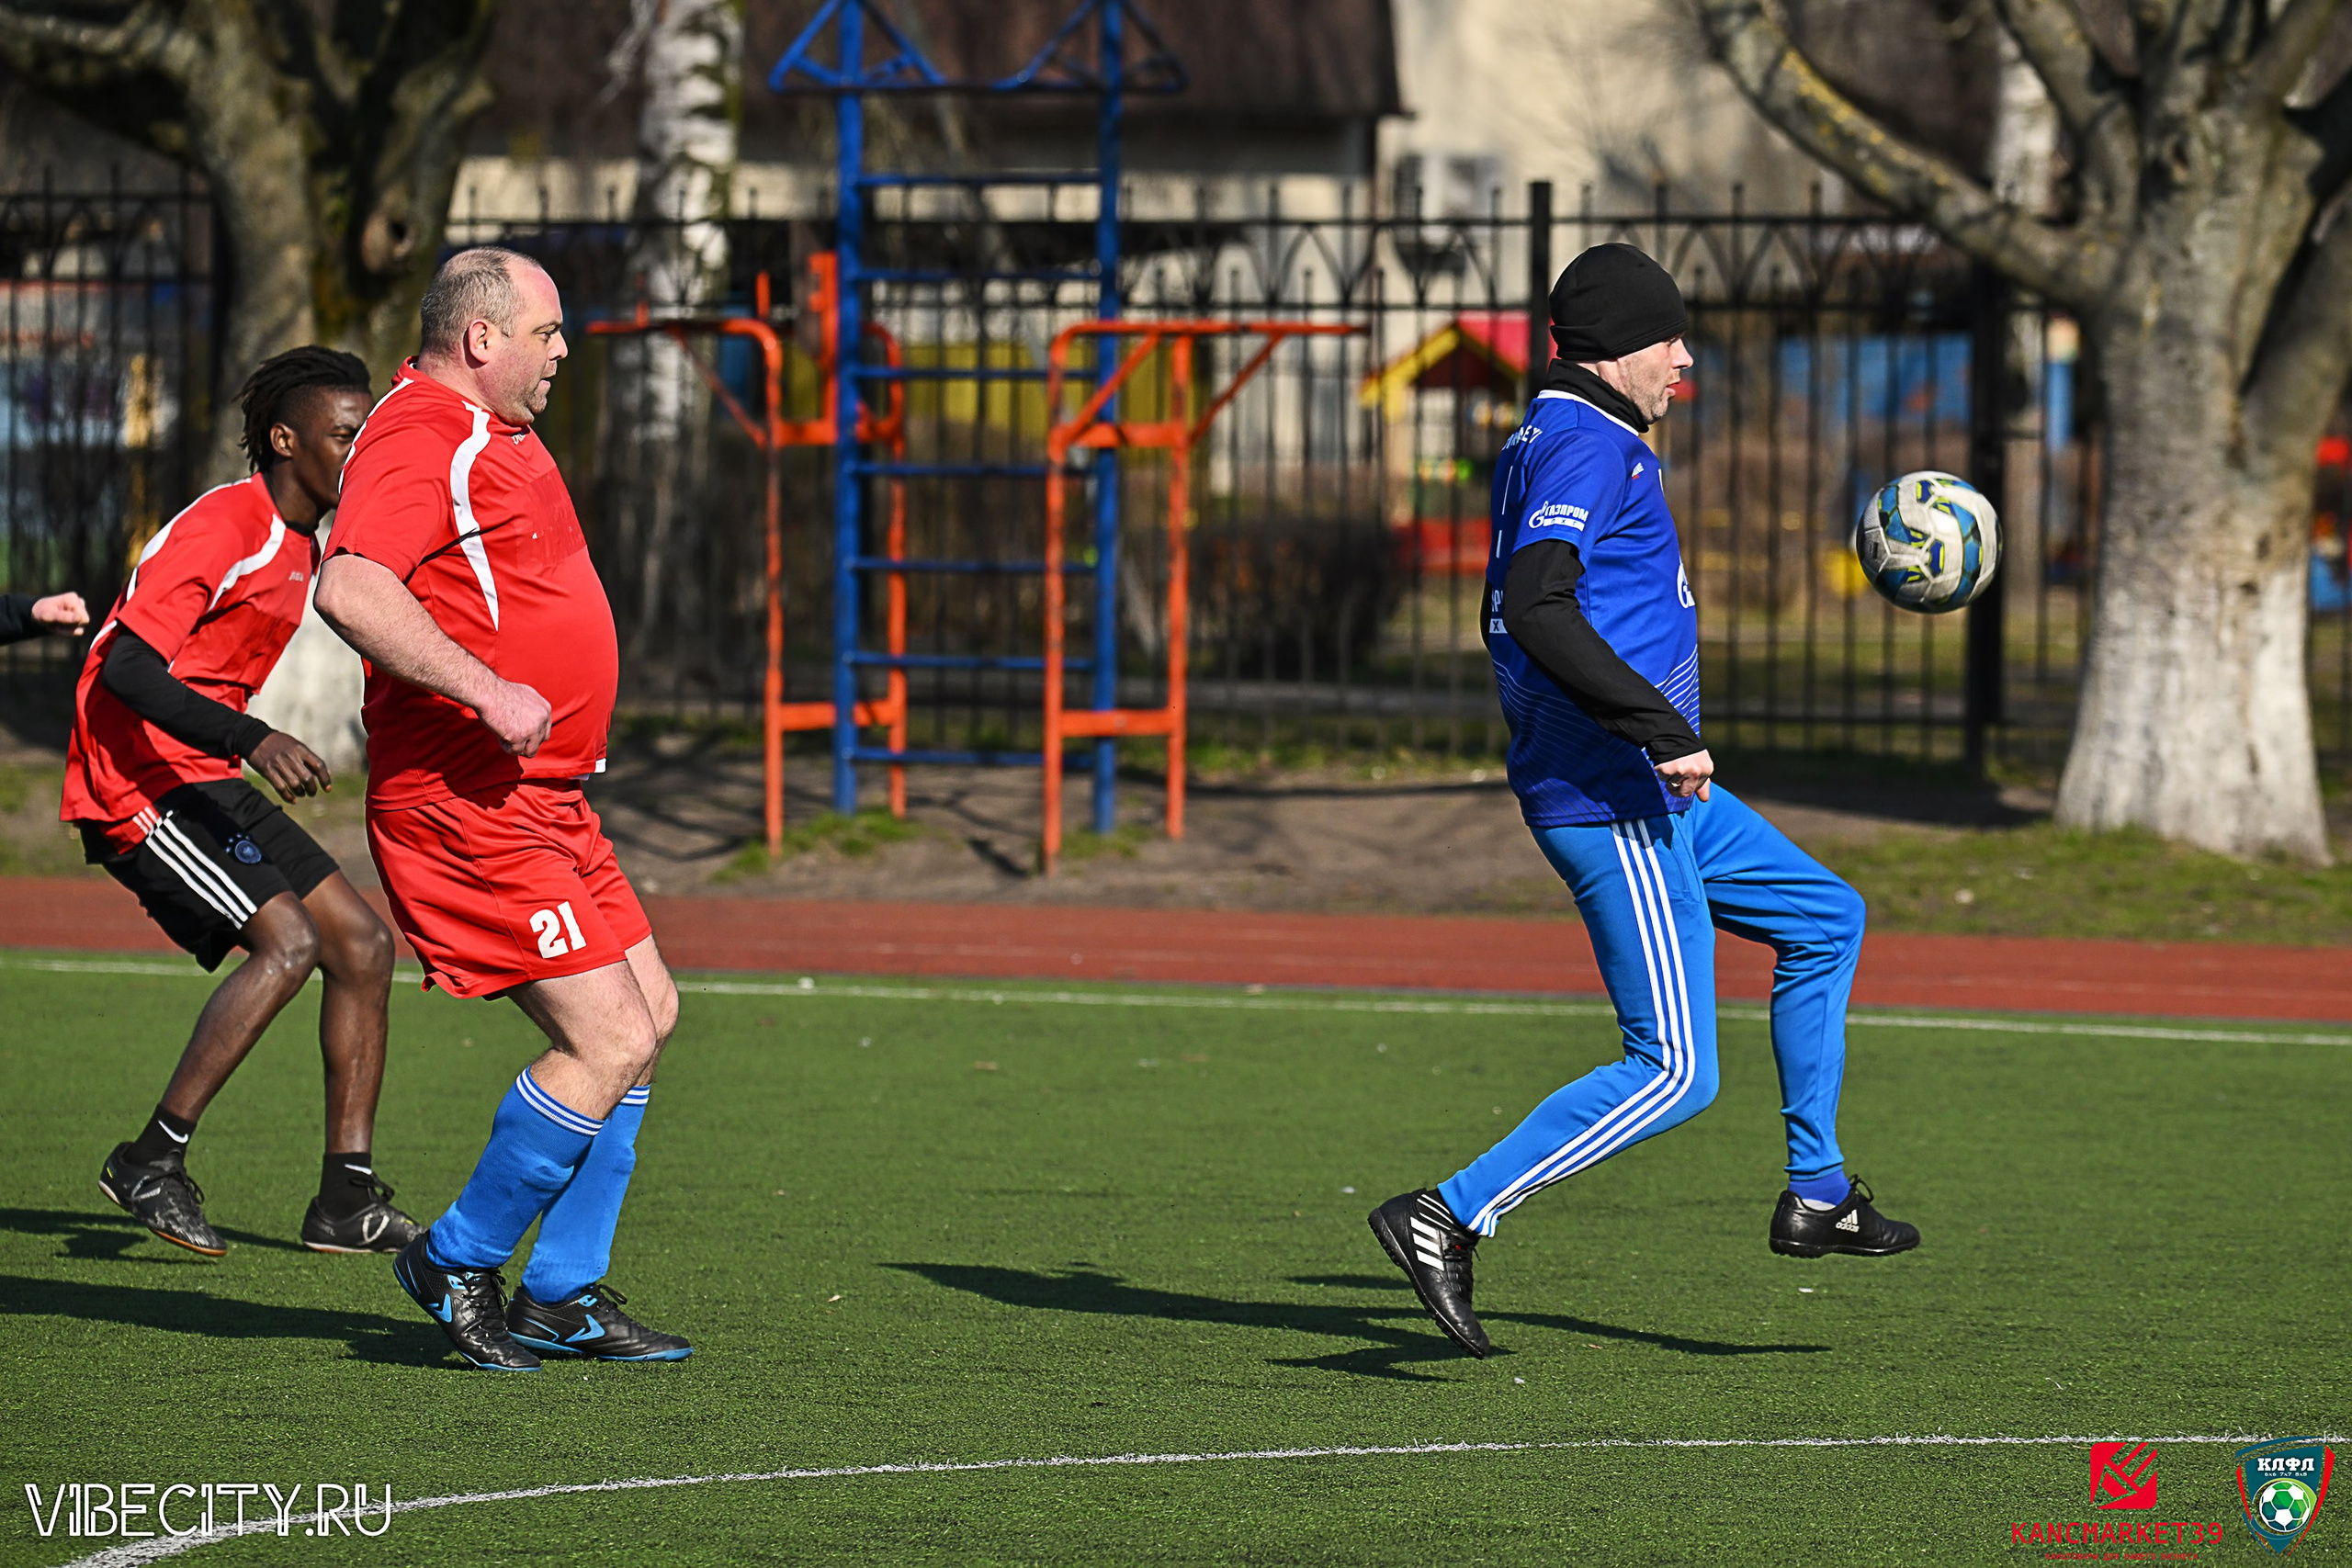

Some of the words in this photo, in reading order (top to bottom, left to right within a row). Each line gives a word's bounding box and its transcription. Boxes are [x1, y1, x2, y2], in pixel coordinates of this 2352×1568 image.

[1544, 504, 1589, 522] ГАЗПРОМ
[529, 900, 587, 959] 21
[1835, 1222, 1860, 1233] adidas
